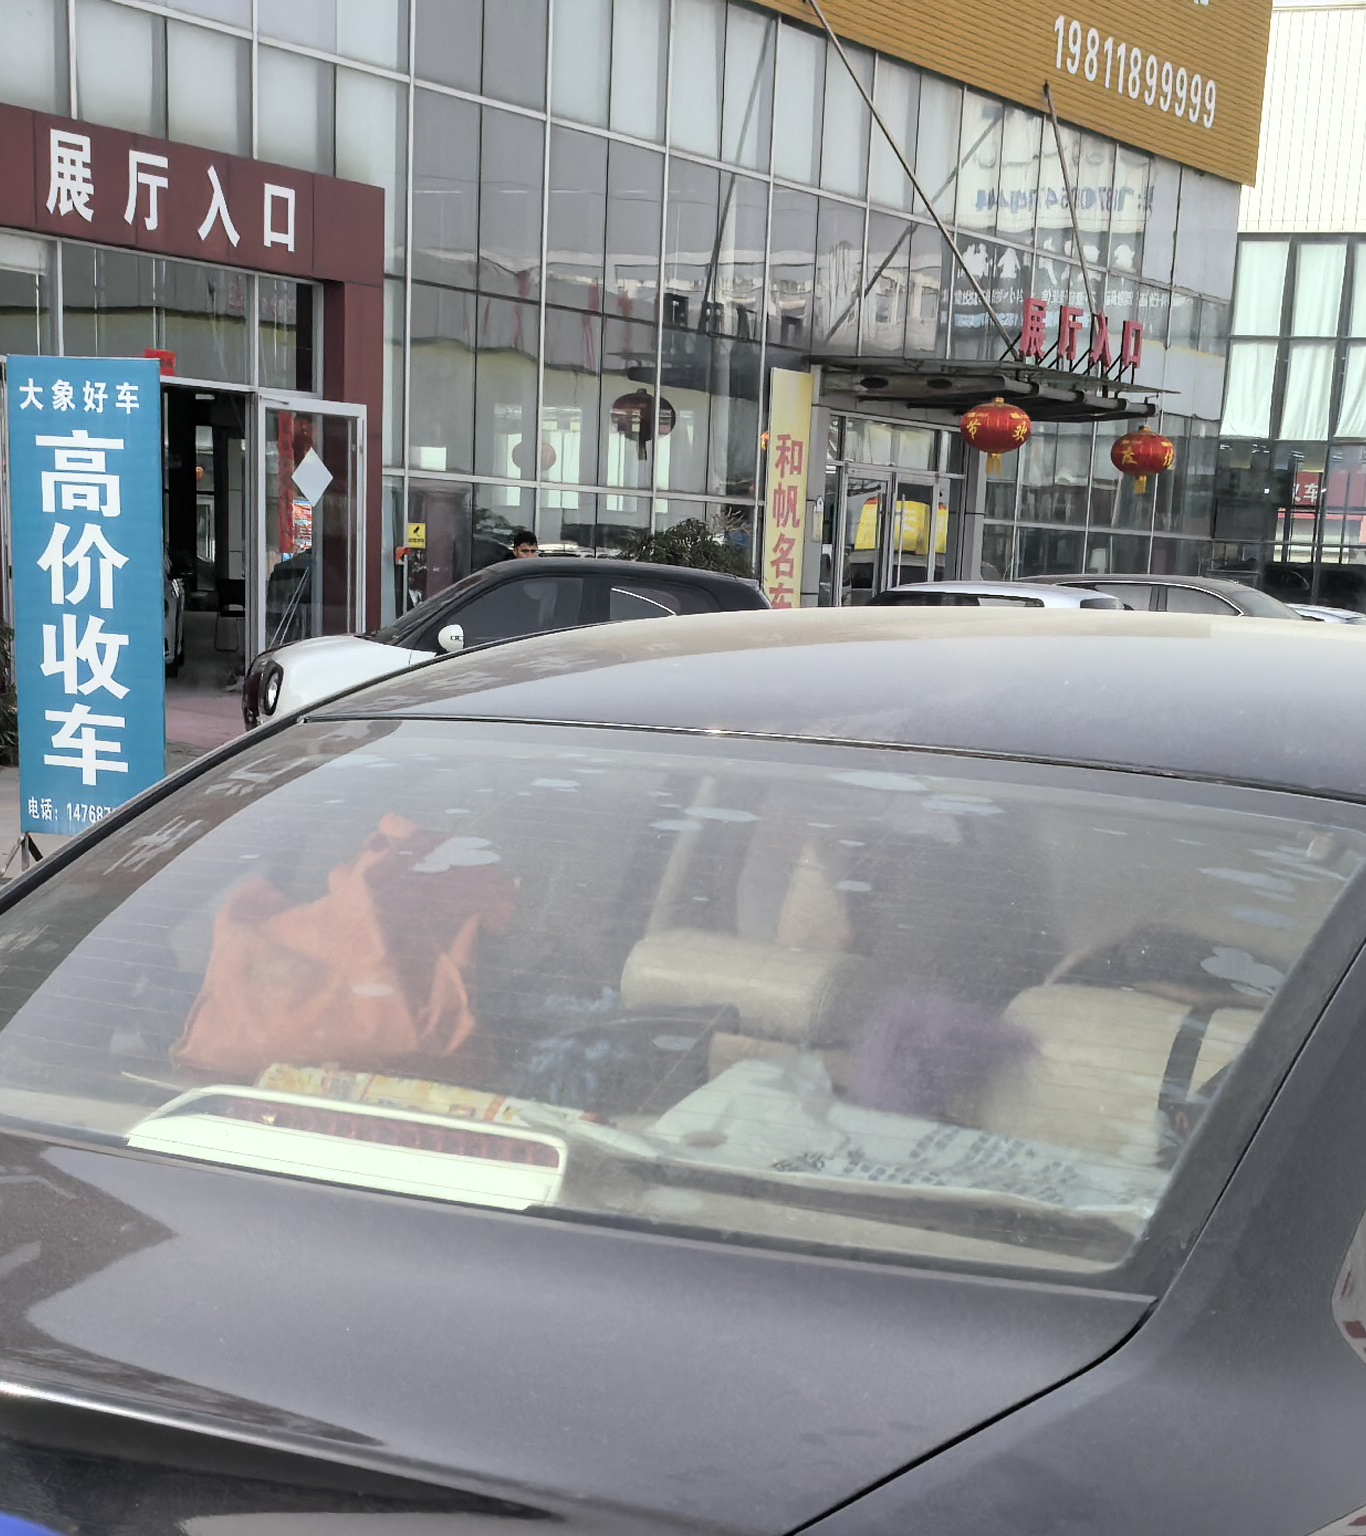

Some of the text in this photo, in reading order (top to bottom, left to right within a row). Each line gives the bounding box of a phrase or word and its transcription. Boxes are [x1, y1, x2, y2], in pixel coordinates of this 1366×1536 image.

[1054, 15, 1217, 129] 19811899999
[46, 128, 296, 252] 展厅入口
[1019, 298, 1143, 368] 展厅入口
[19, 377, 140, 414] 大象好车
[36, 430, 130, 786] 高价收车
